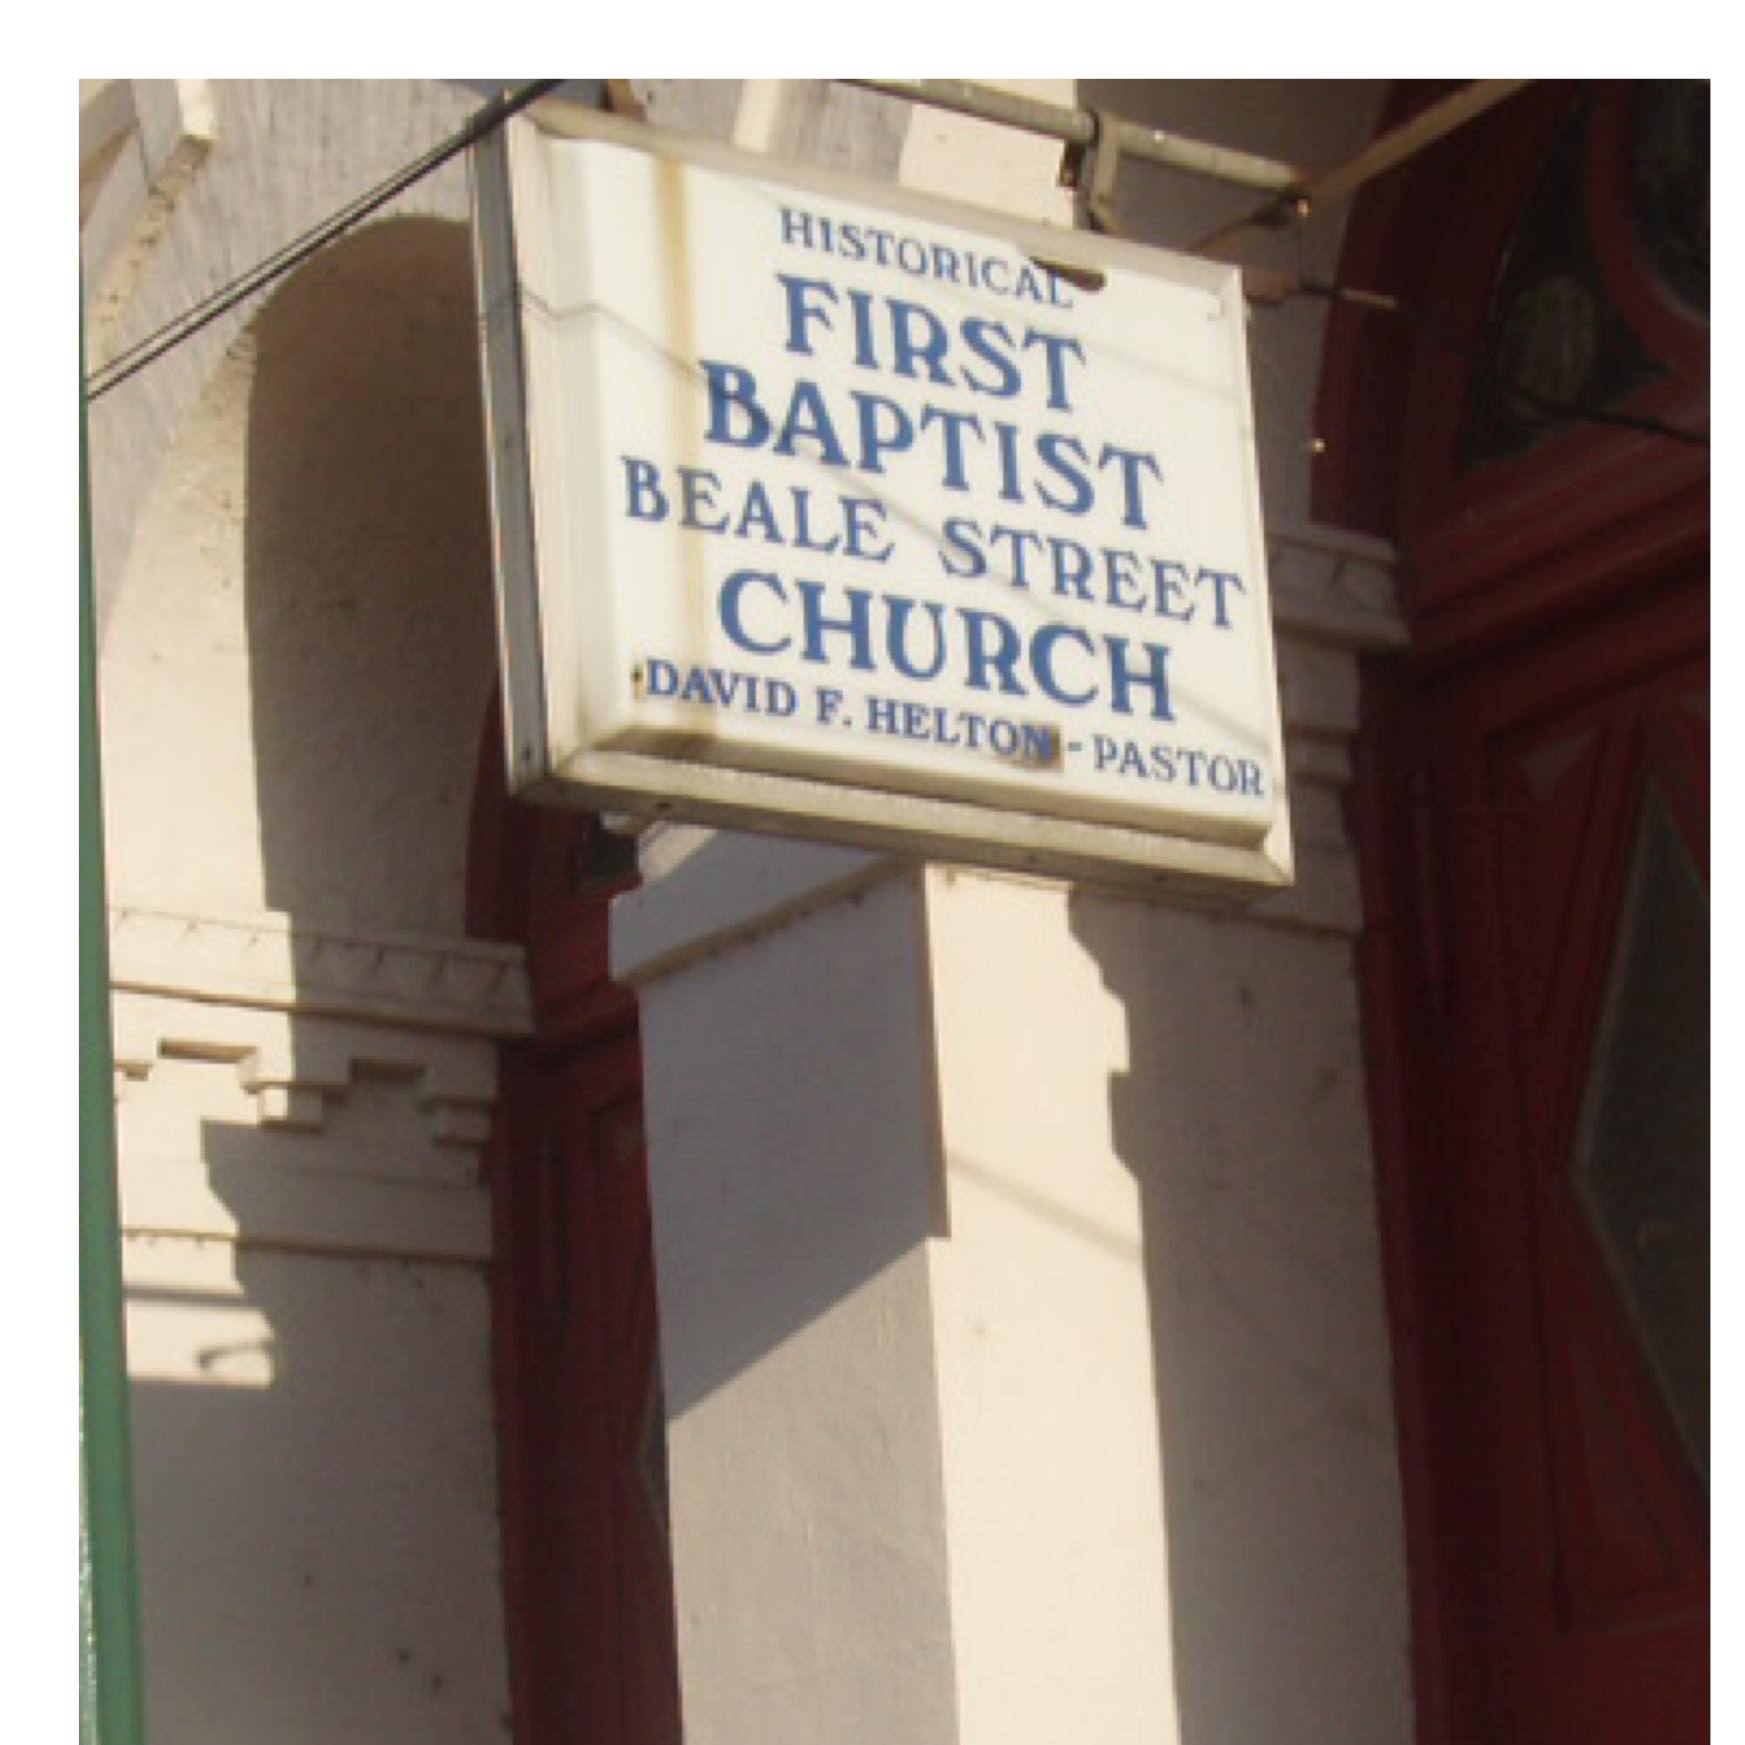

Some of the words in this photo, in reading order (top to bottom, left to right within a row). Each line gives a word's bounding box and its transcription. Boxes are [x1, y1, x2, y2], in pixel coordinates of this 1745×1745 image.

[779, 207, 1074, 310] HISTORICAL
[775, 273, 1086, 412] FIRST
[700, 359, 1163, 529] BAPTIST
[621, 456, 895, 563] BEALE
[938, 516, 1246, 630] STREET
[718, 569, 1177, 720] CHURCH
[646, 658, 797, 717] DAVID
[816, 689, 852, 727] F.
[867, 696, 1053, 761] HELTON
[1093, 733, 1264, 796] PASTOR
